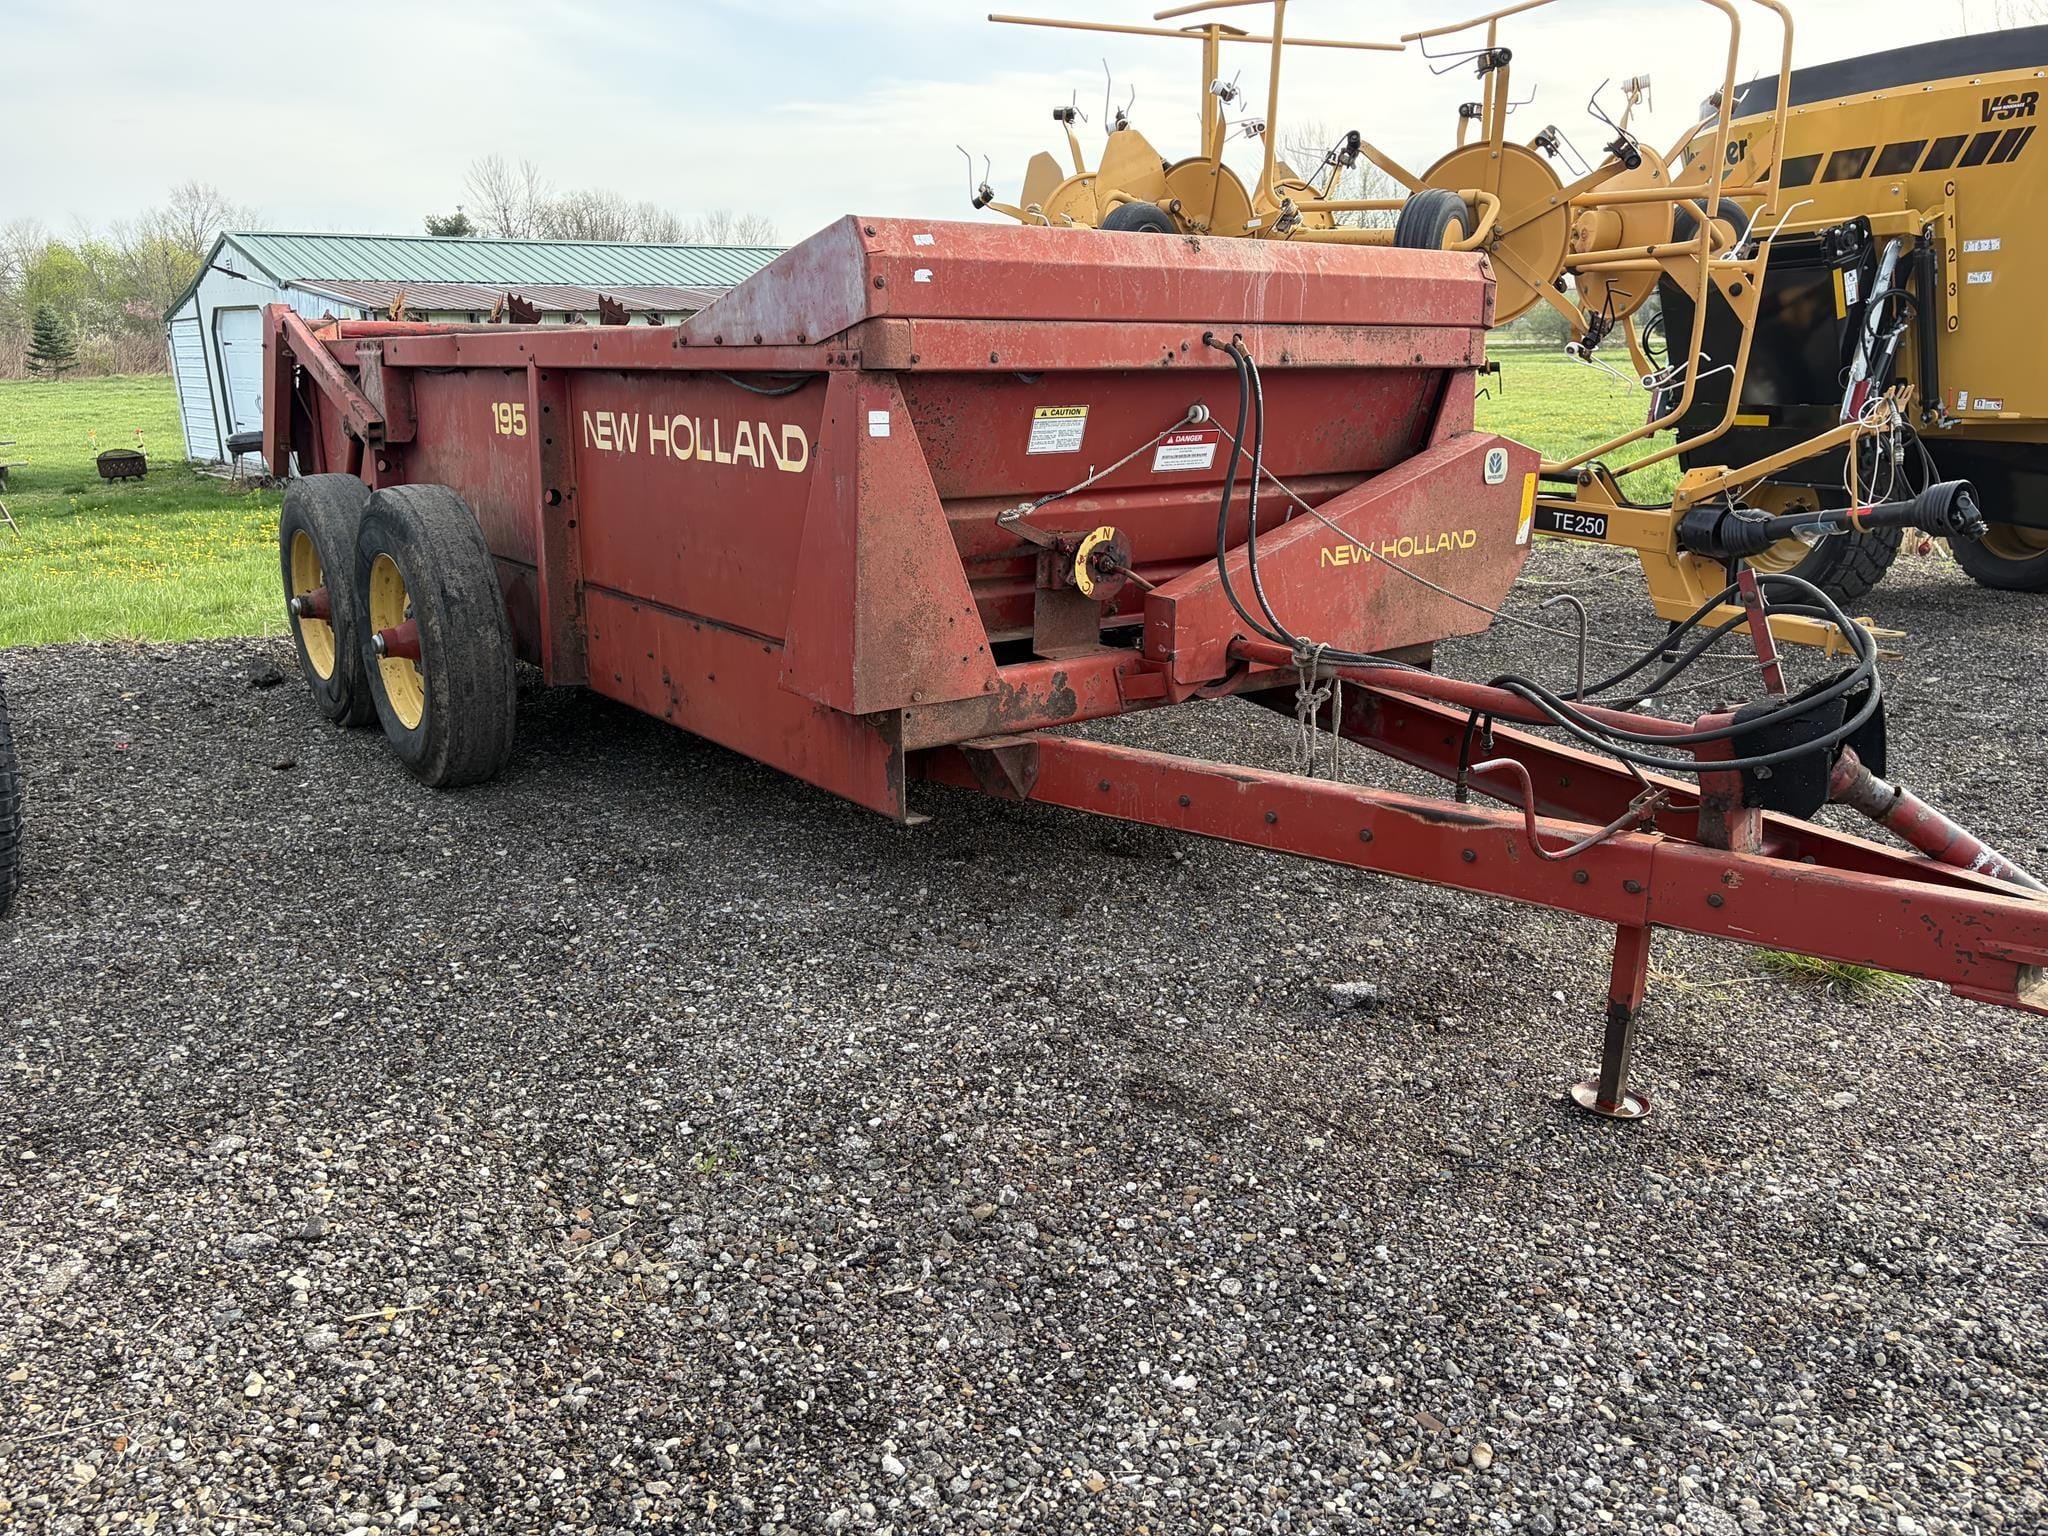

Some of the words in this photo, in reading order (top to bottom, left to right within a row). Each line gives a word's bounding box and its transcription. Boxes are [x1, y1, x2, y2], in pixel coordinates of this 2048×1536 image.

[1981, 91, 2040, 123] VSR
[1944, 181, 1955, 197] C
[1947, 215, 1954, 229] 1
[1947, 248, 1956, 263] 2
[1948, 282, 1957, 297] 3
[491, 402, 527, 437] 195
[1050, 408, 1082, 416] CAUTION
[582, 410, 640, 454] NEW
[648, 413, 810, 473] HOLLAND
[1175, 434, 1203, 443] DANGER
[1552, 511, 1606, 537] TE250
[1320, 543, 1376, 568] NEW
[1380, 529, 1478, 560] HOLLAND
